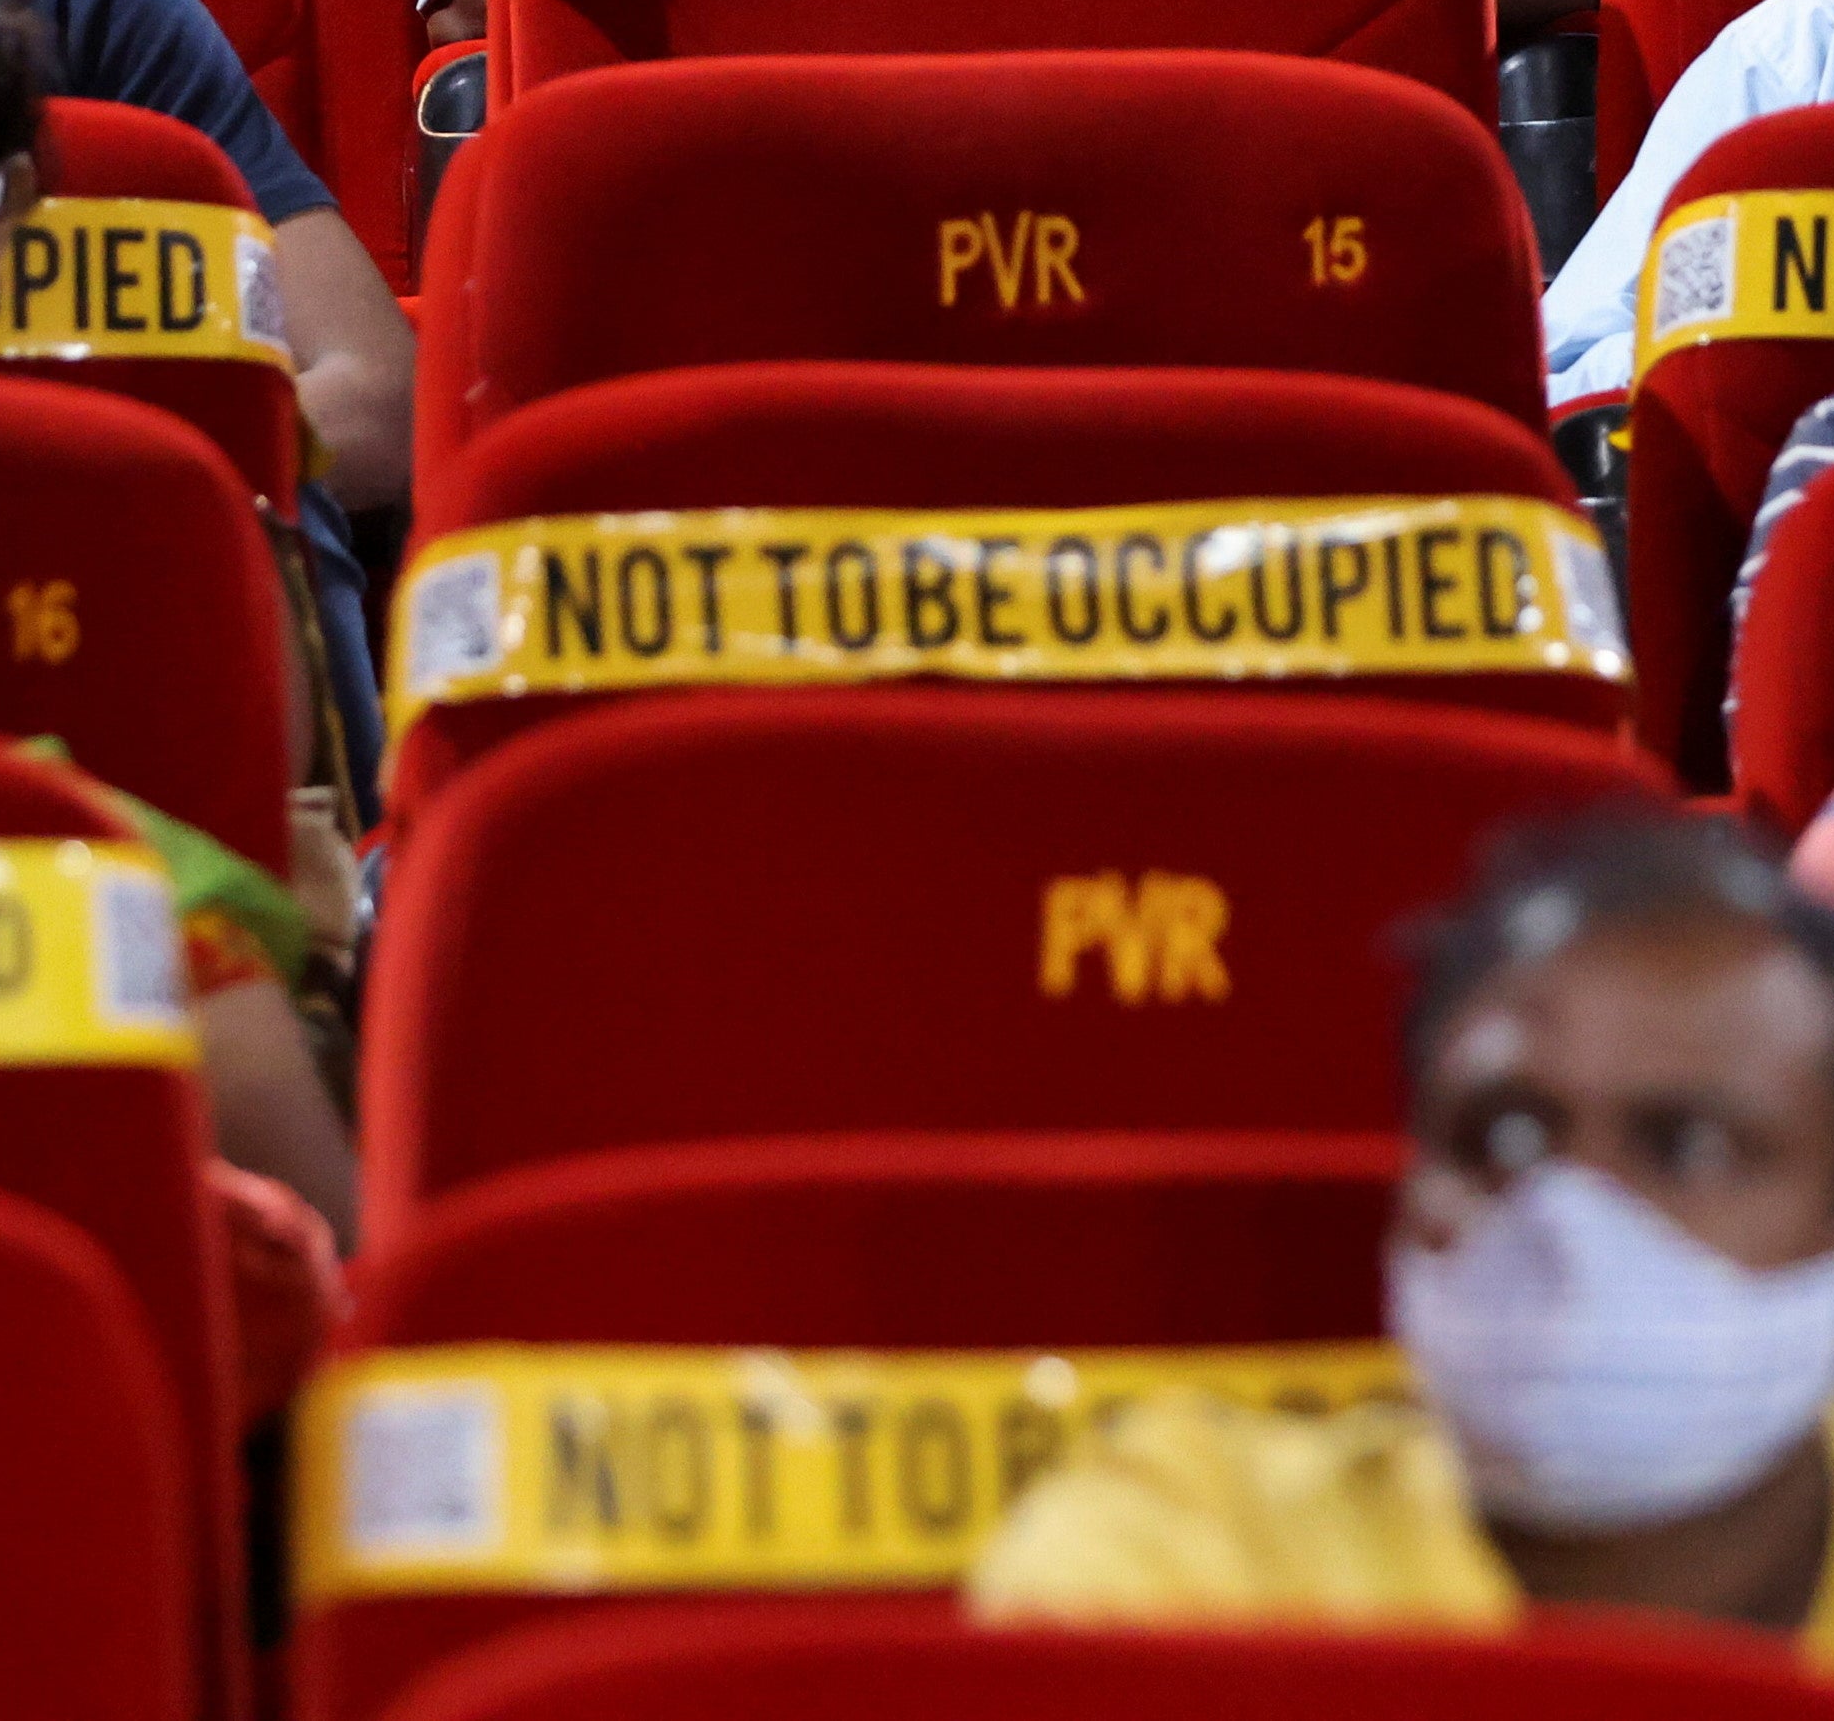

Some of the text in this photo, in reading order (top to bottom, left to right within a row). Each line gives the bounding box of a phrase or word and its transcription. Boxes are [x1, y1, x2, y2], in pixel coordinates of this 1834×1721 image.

[7, 227, 206, 334] PIED
[939, 212, 1366, 305] PVR 15
[545, 528, 1527, 657] NOT TO BE OCCUPIED
[1039, 871, 1231, 1003] PVR
[827, 1395, 972, 1539] TO
